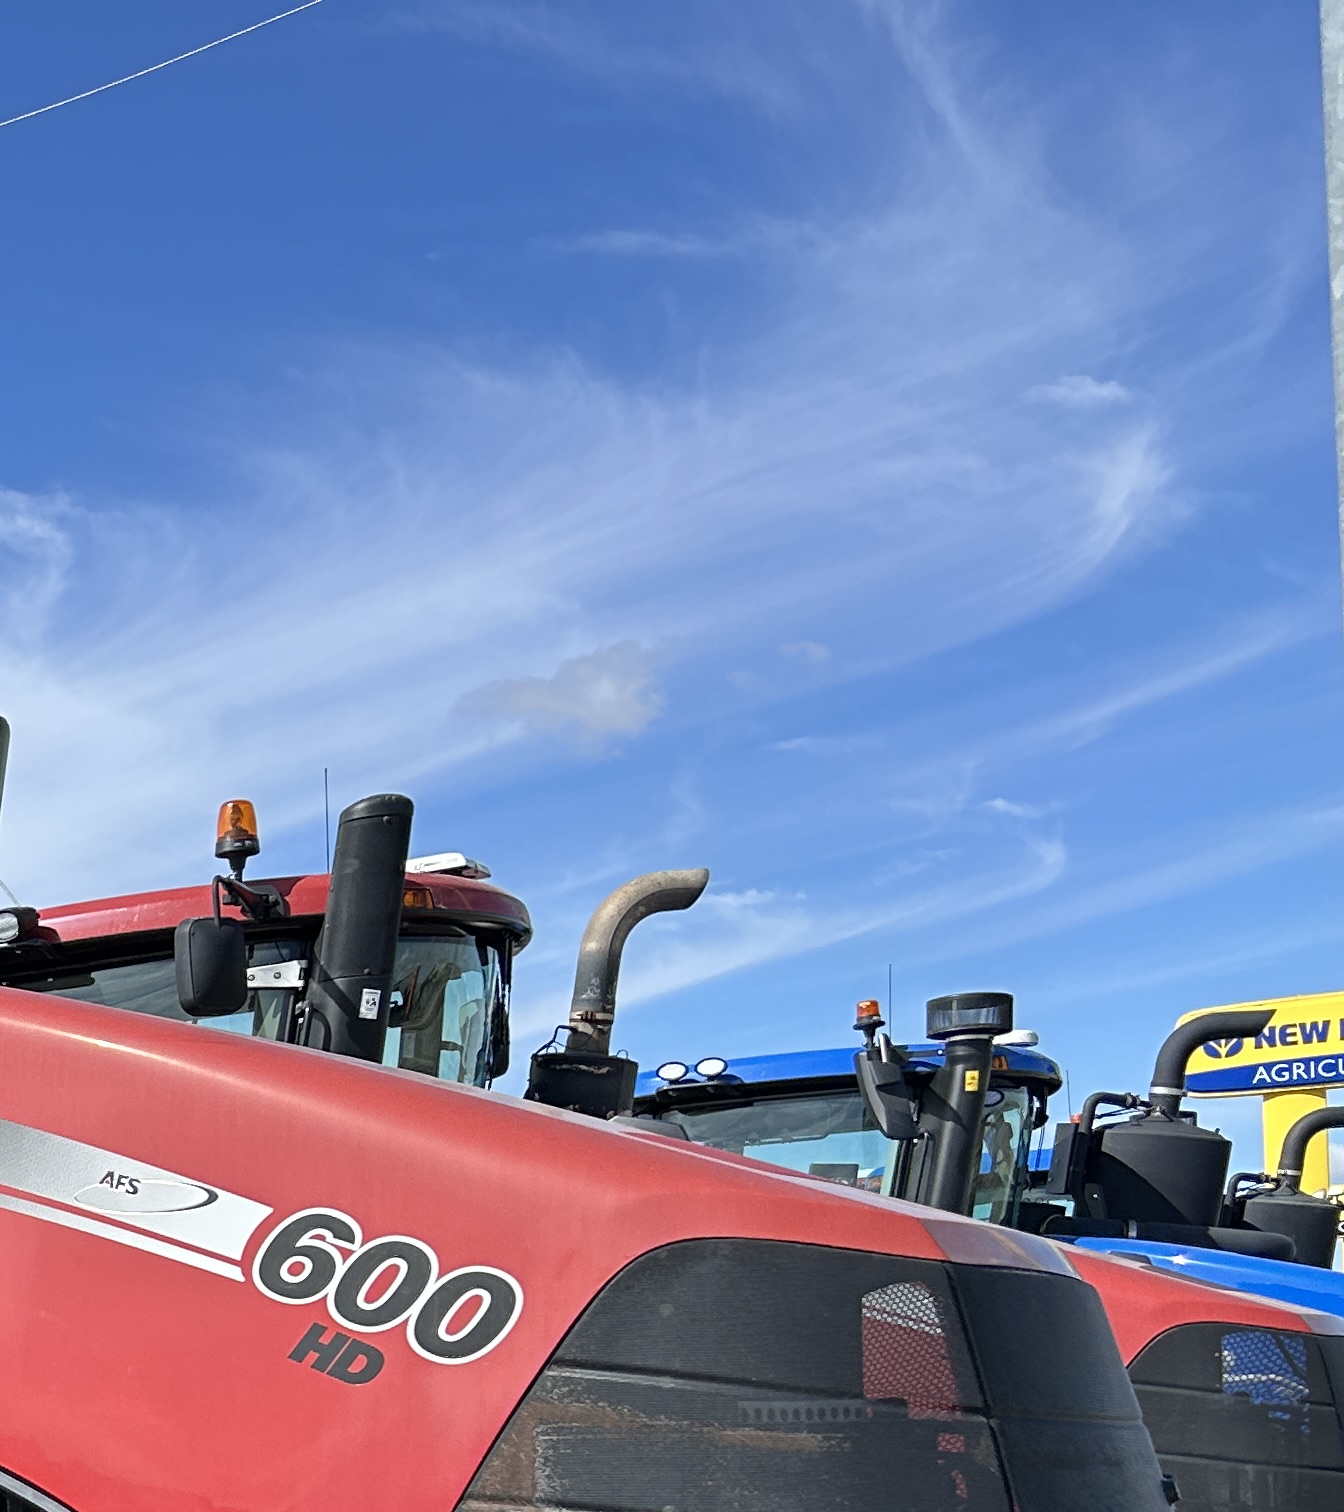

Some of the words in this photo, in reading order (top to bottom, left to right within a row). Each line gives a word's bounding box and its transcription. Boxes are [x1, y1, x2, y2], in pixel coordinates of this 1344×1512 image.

[1254, 1019, 1332, 1050] NEW
[98, 1170, 141, 1195] AFS
[253, 1208, 523, 1364] 600
[288, 1322, 386, 1386] HD
